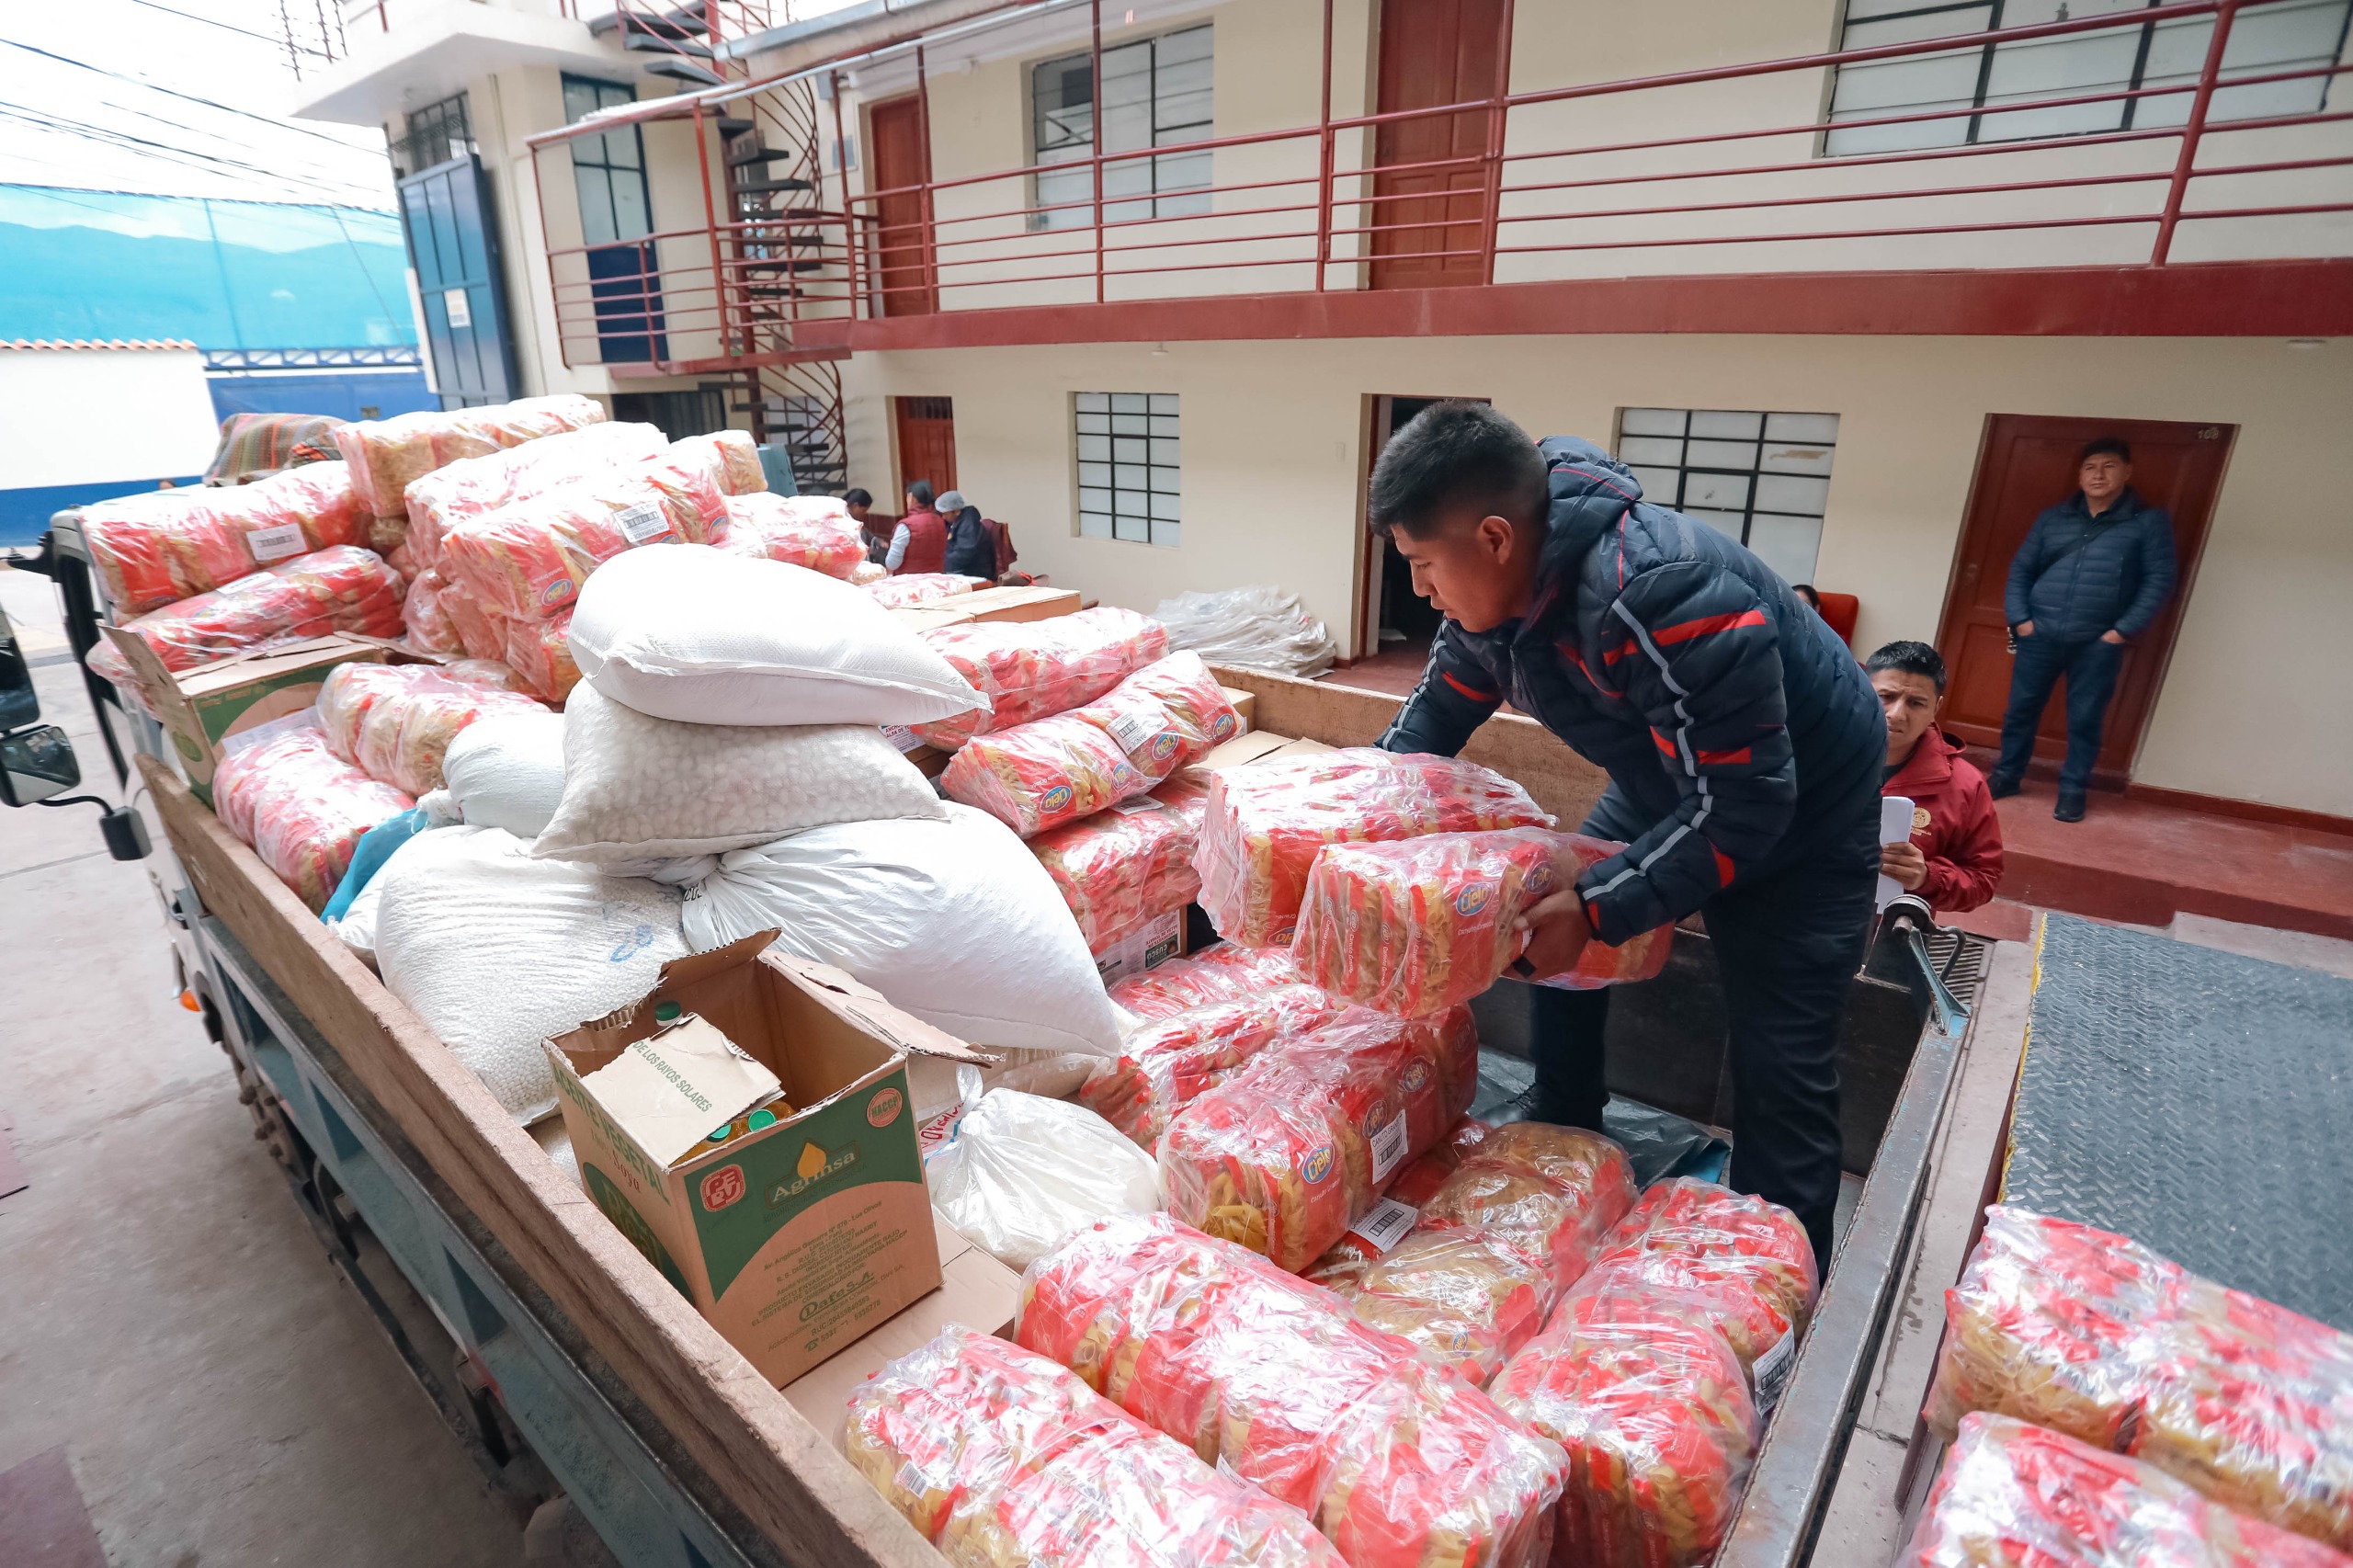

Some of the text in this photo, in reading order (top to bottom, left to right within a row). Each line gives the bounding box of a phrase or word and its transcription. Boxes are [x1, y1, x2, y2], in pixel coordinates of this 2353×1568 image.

[1155, 733, 1178, 756] Cielo
[1045, 788, 1069, 810] Cielo
[1460, 885, 1488, 913] Cielo
[1146, 943, 1168, 961] CUSCO
[632, 1040, 713, 1114] DE LOS RAYOS SOLARES
[871, 1096, 899, 1119] HACCP
[596, 1108, 672, 1206] VEGETAL
[612, 1149, 642, 1194] Soya
[1306, 1147, 1332, 1182] Cielo
[756, 1289, 798, 1317] PRODUCTO
[797, 1267, 835, 1293] ENVASADO
[795, 1283, 847, 1324] Dafe
